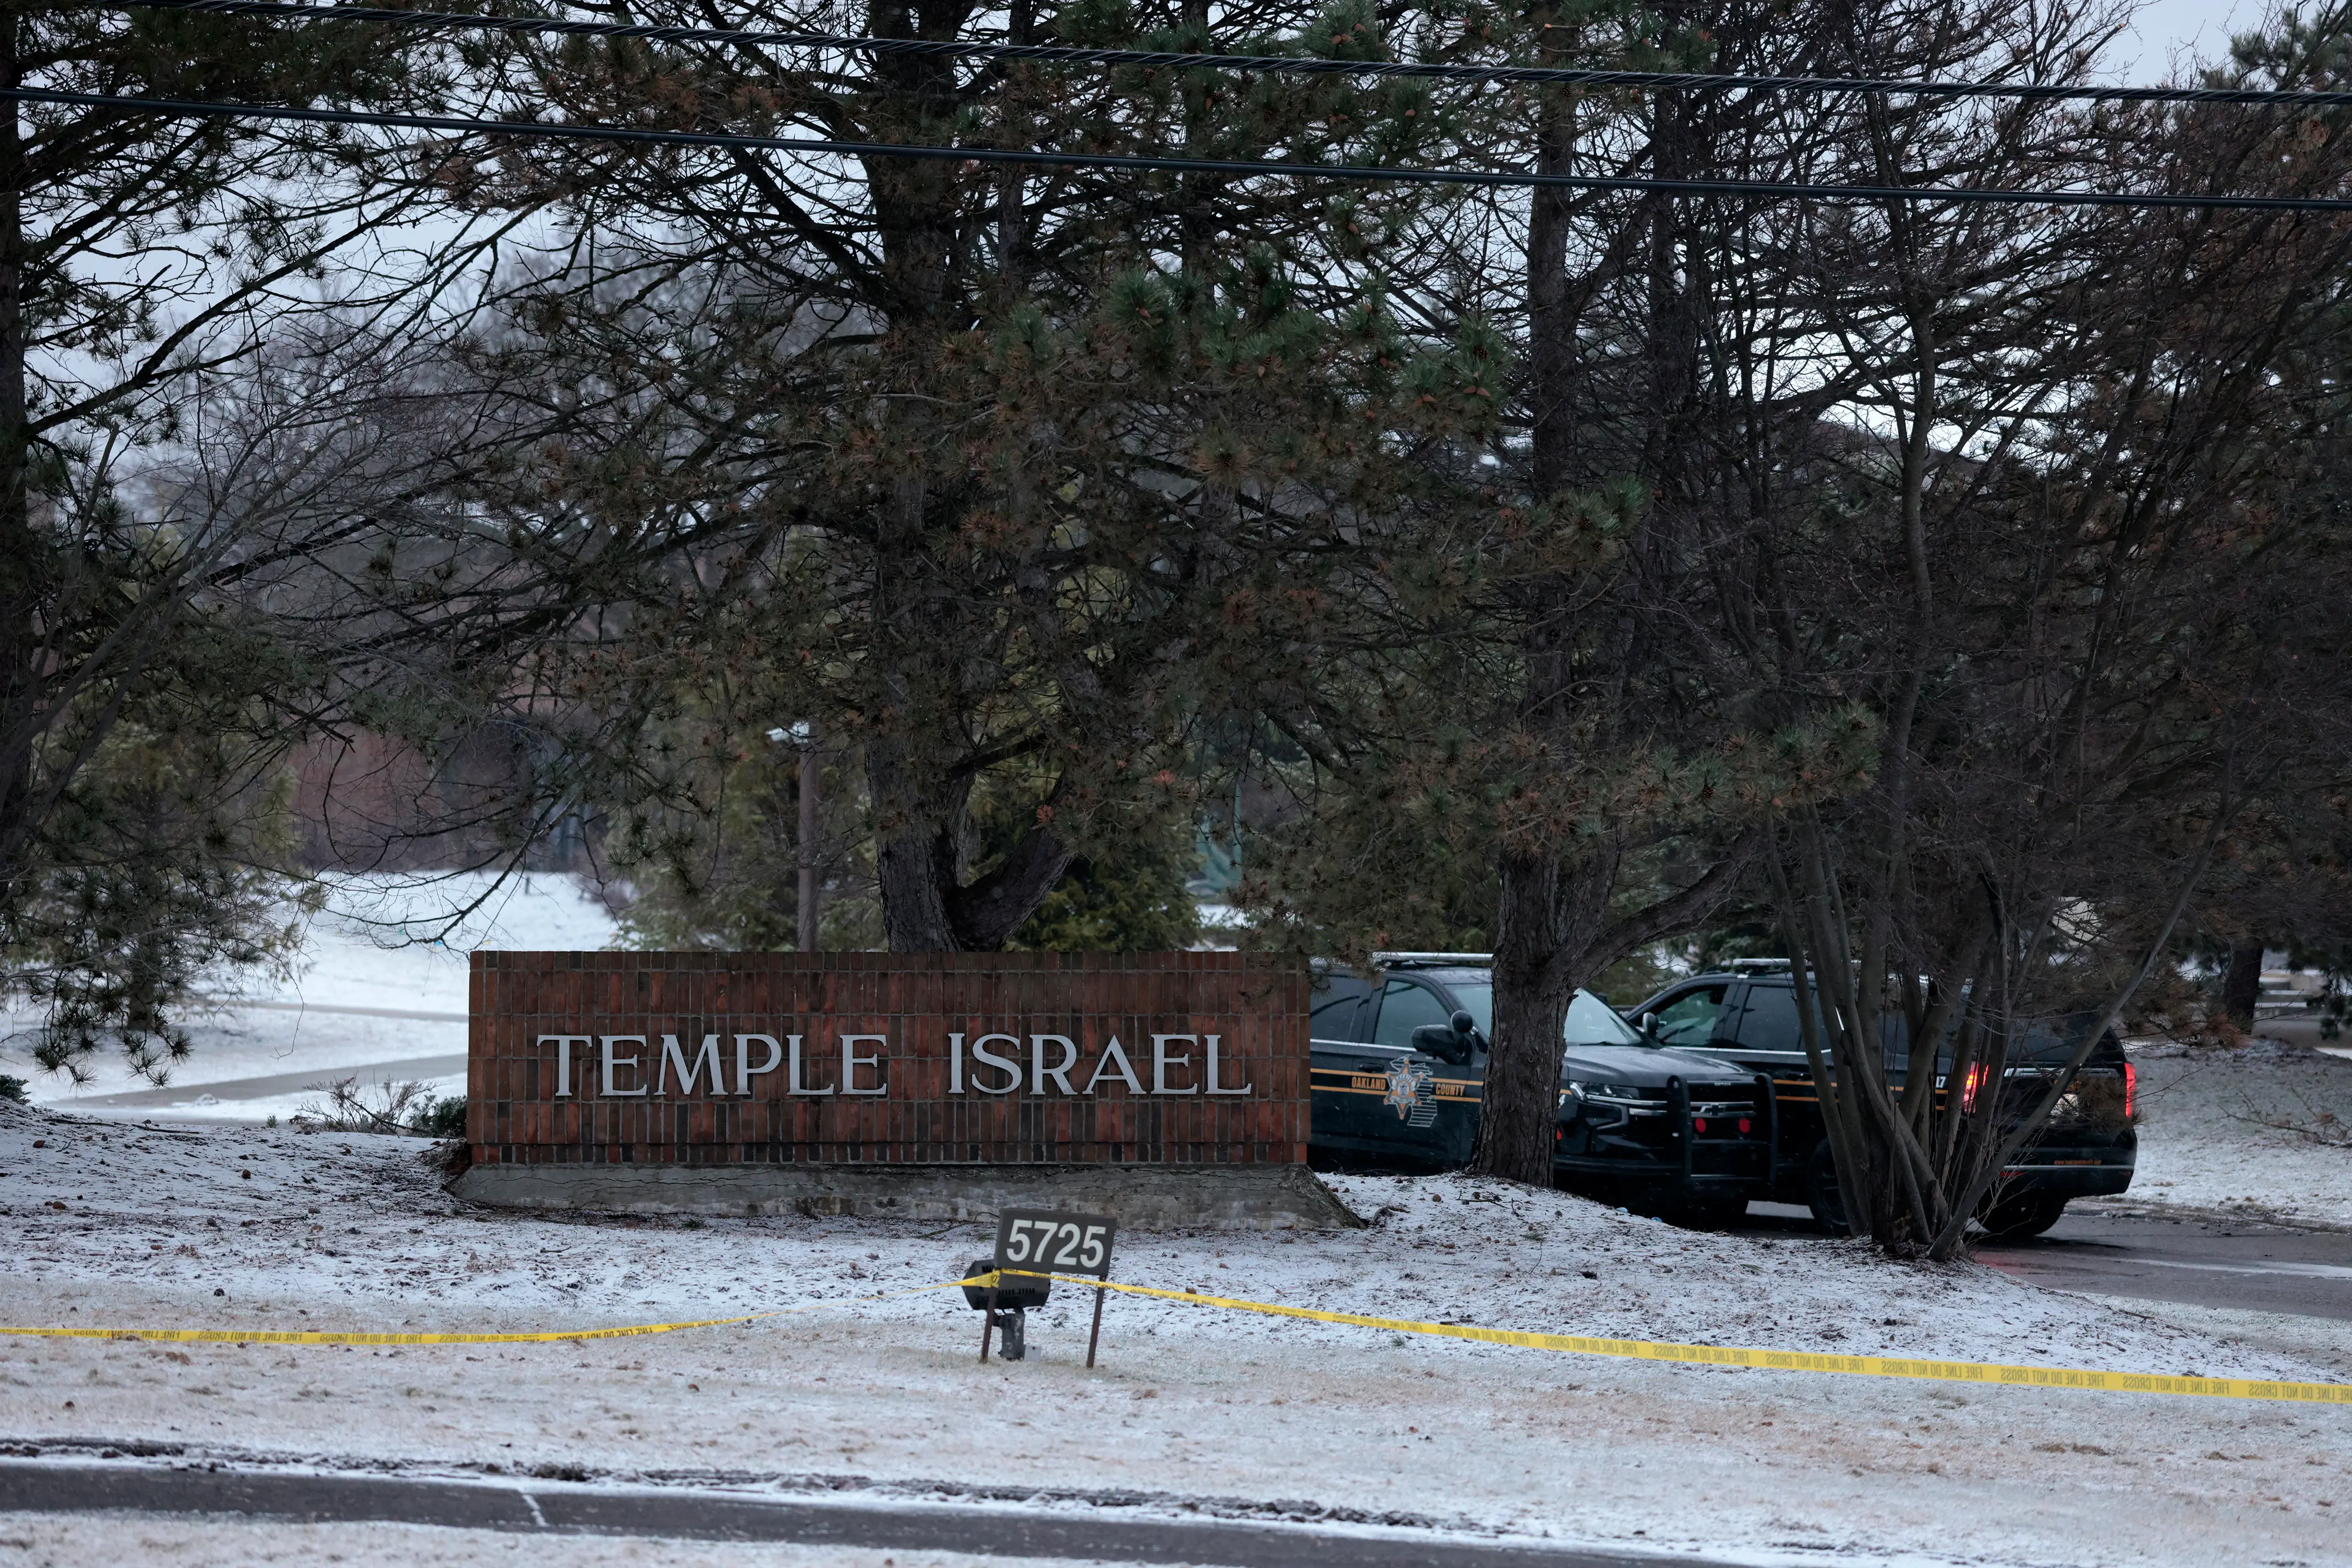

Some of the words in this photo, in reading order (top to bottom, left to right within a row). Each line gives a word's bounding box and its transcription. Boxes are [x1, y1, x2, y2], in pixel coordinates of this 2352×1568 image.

[536, 1034, 887, 1096] TEMPLE
[948, 1032, 1252, 1095] ISRAEL
[1352, 1076, 1387, 1091] OAKLAND
[1435, 1083, 1466, 1096] COUNTY
[1006, 1219, 1106, 1268] 5725
